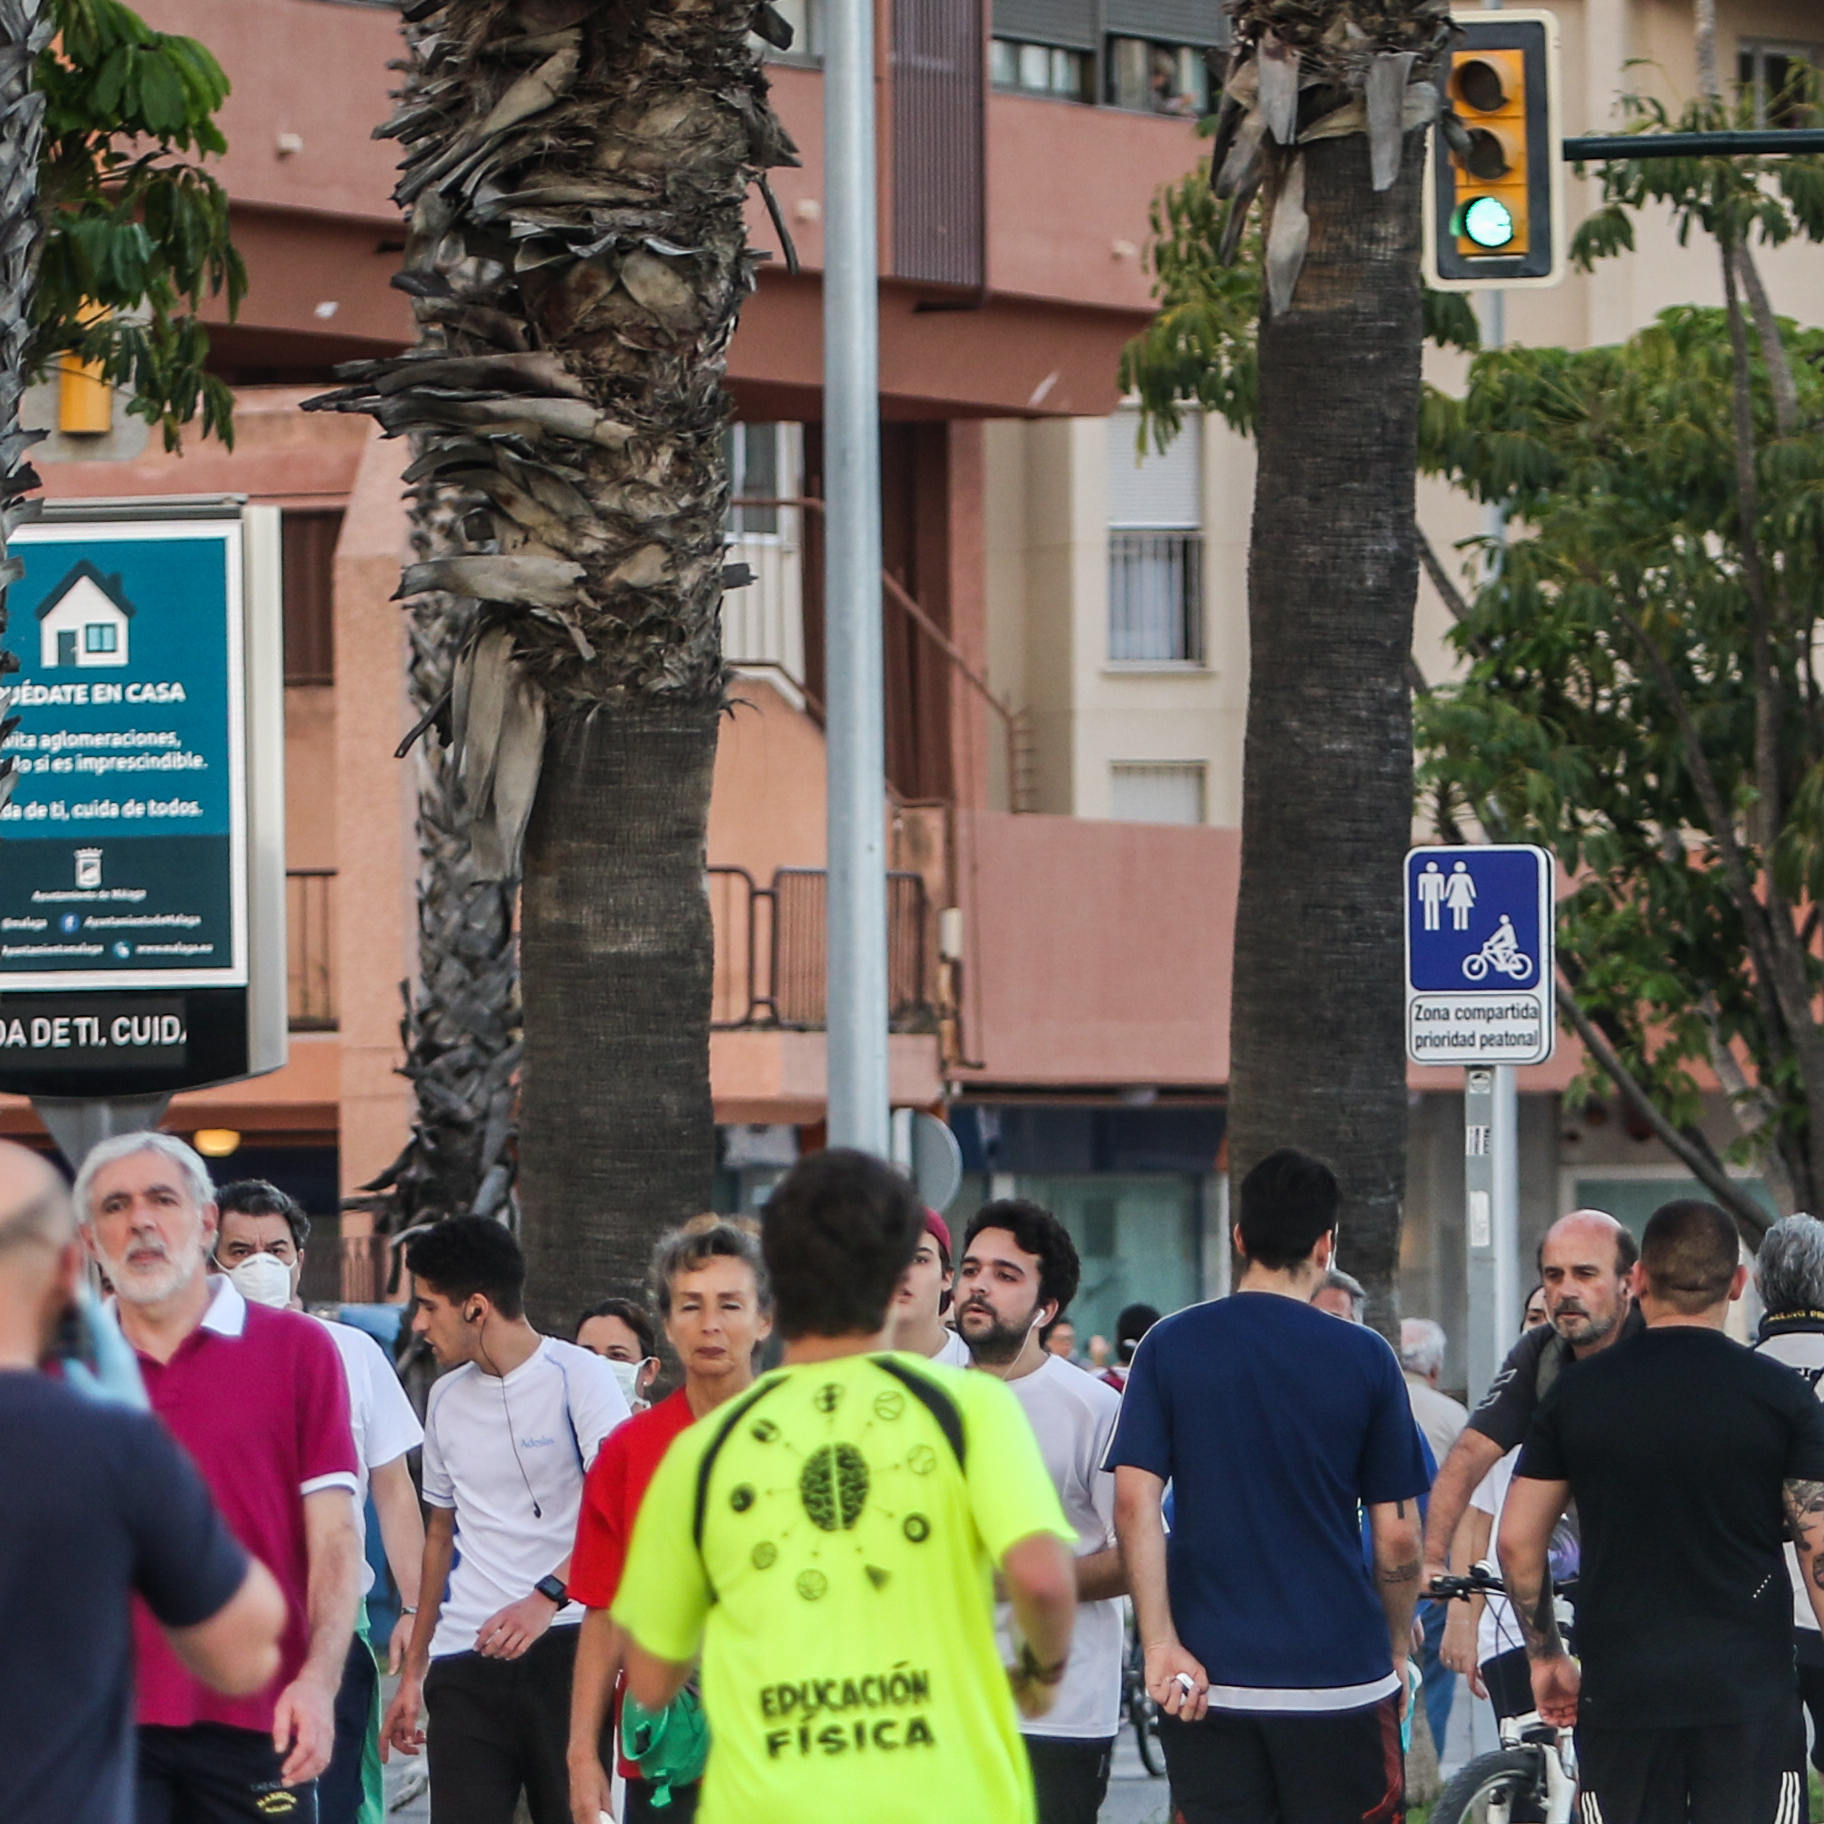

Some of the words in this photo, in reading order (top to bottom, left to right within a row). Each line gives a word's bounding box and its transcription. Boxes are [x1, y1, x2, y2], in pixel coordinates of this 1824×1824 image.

[91, 683, 122, 704] EN
[126, 682, 186, 703] CASA
[1, 731, 37, 750] vita
[39, 729, 181, 753] aglomeraciones,
[33, 754, 49, 773] si
[51, 757, 73, 773] es
[75, 751, 208, 775] imprescindible.
[24, 801, 48, 820] de
[71, 799, 119, 819] cuida
[121, 799, 146, 818] de
[147, 798, 203, 817] todos.
[1415, 1004, 1449, 1020] Zona
[1455, 1003, 1537, 1022] compartida
[31, 1017, 71, 1048] DE
[111, 1014, 187, 1046] CUID
[1415, 1031, 1475, 1051] prioridad
[1479, 1030, 1537, 1050] peatonal
[760, 1660, 929, 1719] EDUCACIÓN
[765, 1712, 935, 1758] FÍSICA
